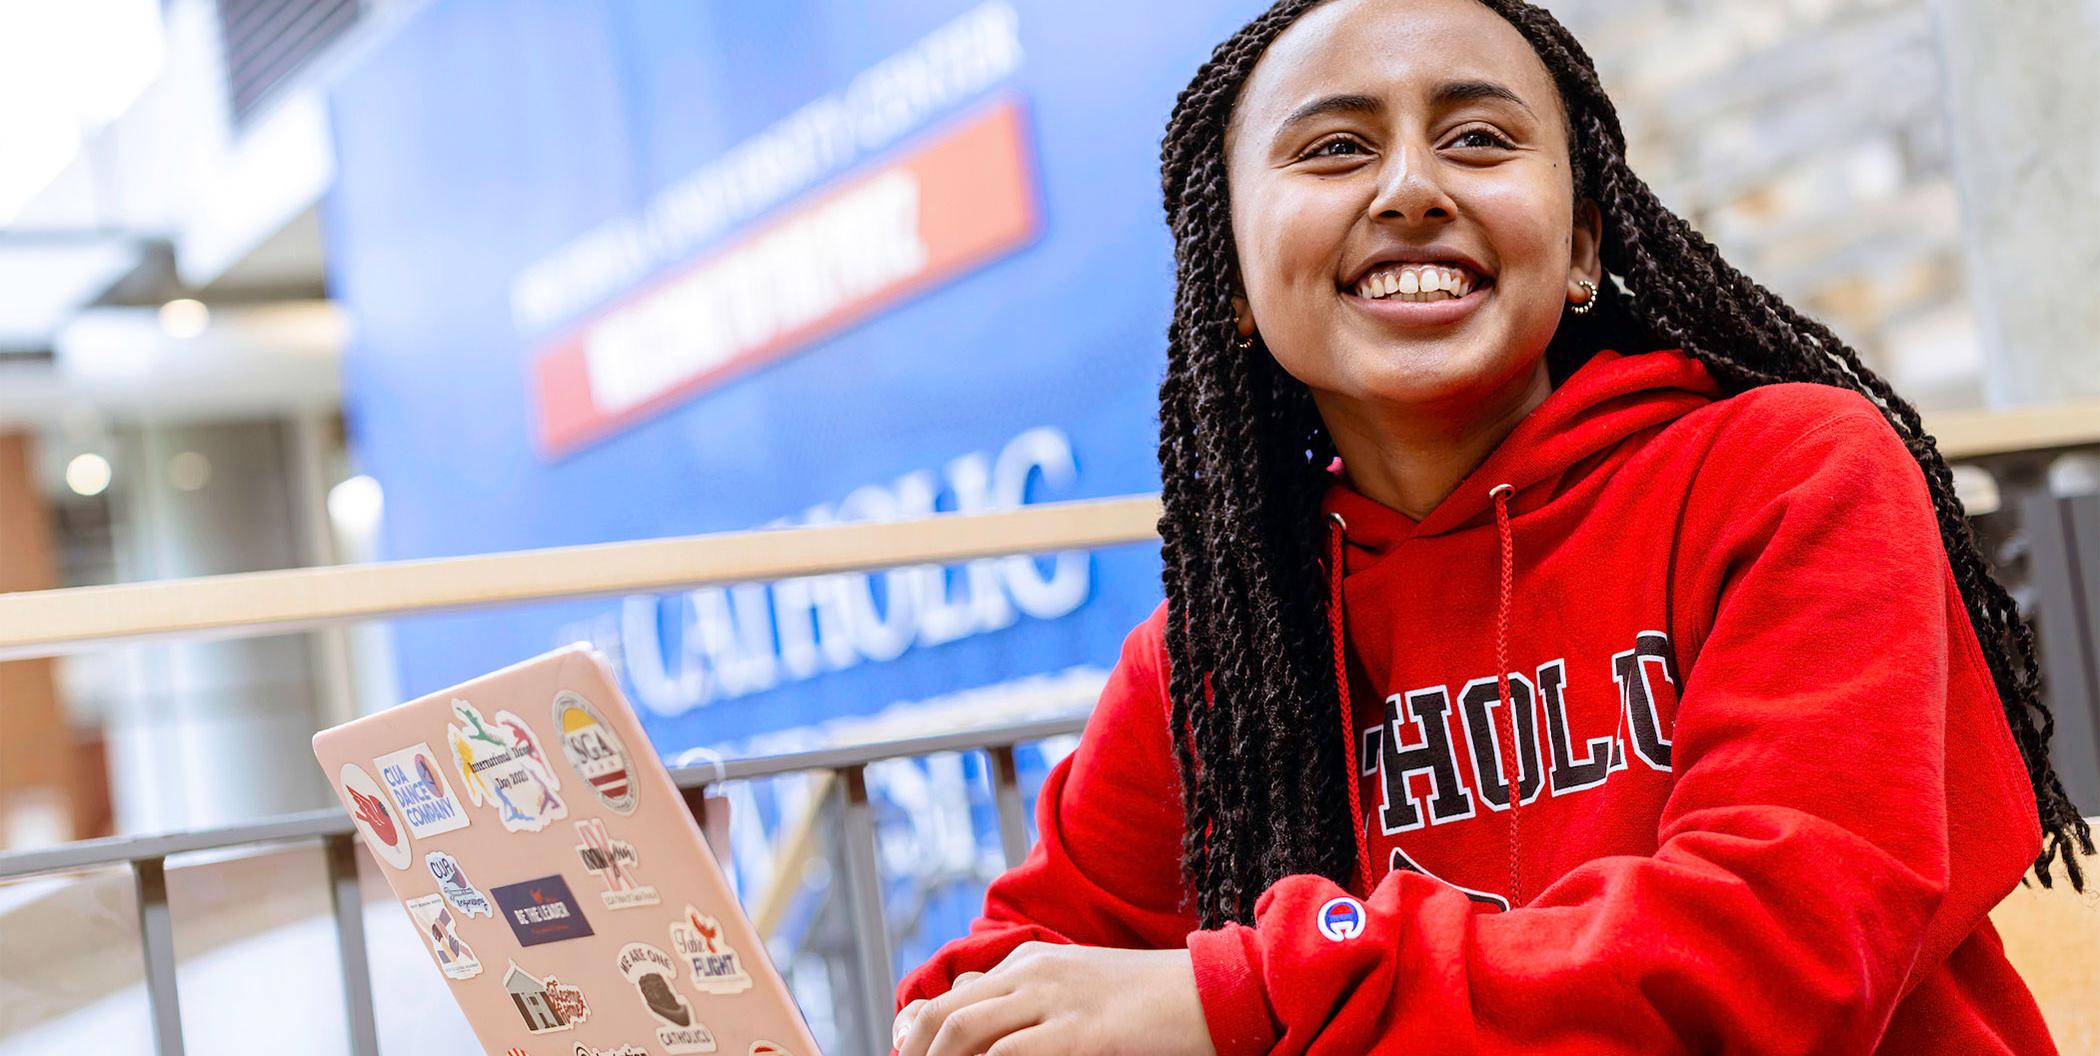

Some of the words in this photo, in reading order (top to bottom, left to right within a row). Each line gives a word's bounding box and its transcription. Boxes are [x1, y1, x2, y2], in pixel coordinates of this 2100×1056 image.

[1363, 630, 1673, 836] HOLIC
[570, 730, 615, 764] SGA
[384, 764, 409, 787] CUA
[496, 777, 512, 790] Day
[393, 780, 431, 808] DANCE
[406, 796, 456, 827] COMPANY
[430, 858, 453, 879] CUA
[514, 909, 530, 925] BE
[629, 948, 647, 963] ARE
[647, 950, 671, 970] ONE
[692, 954, 737, 977] FLIGHT
